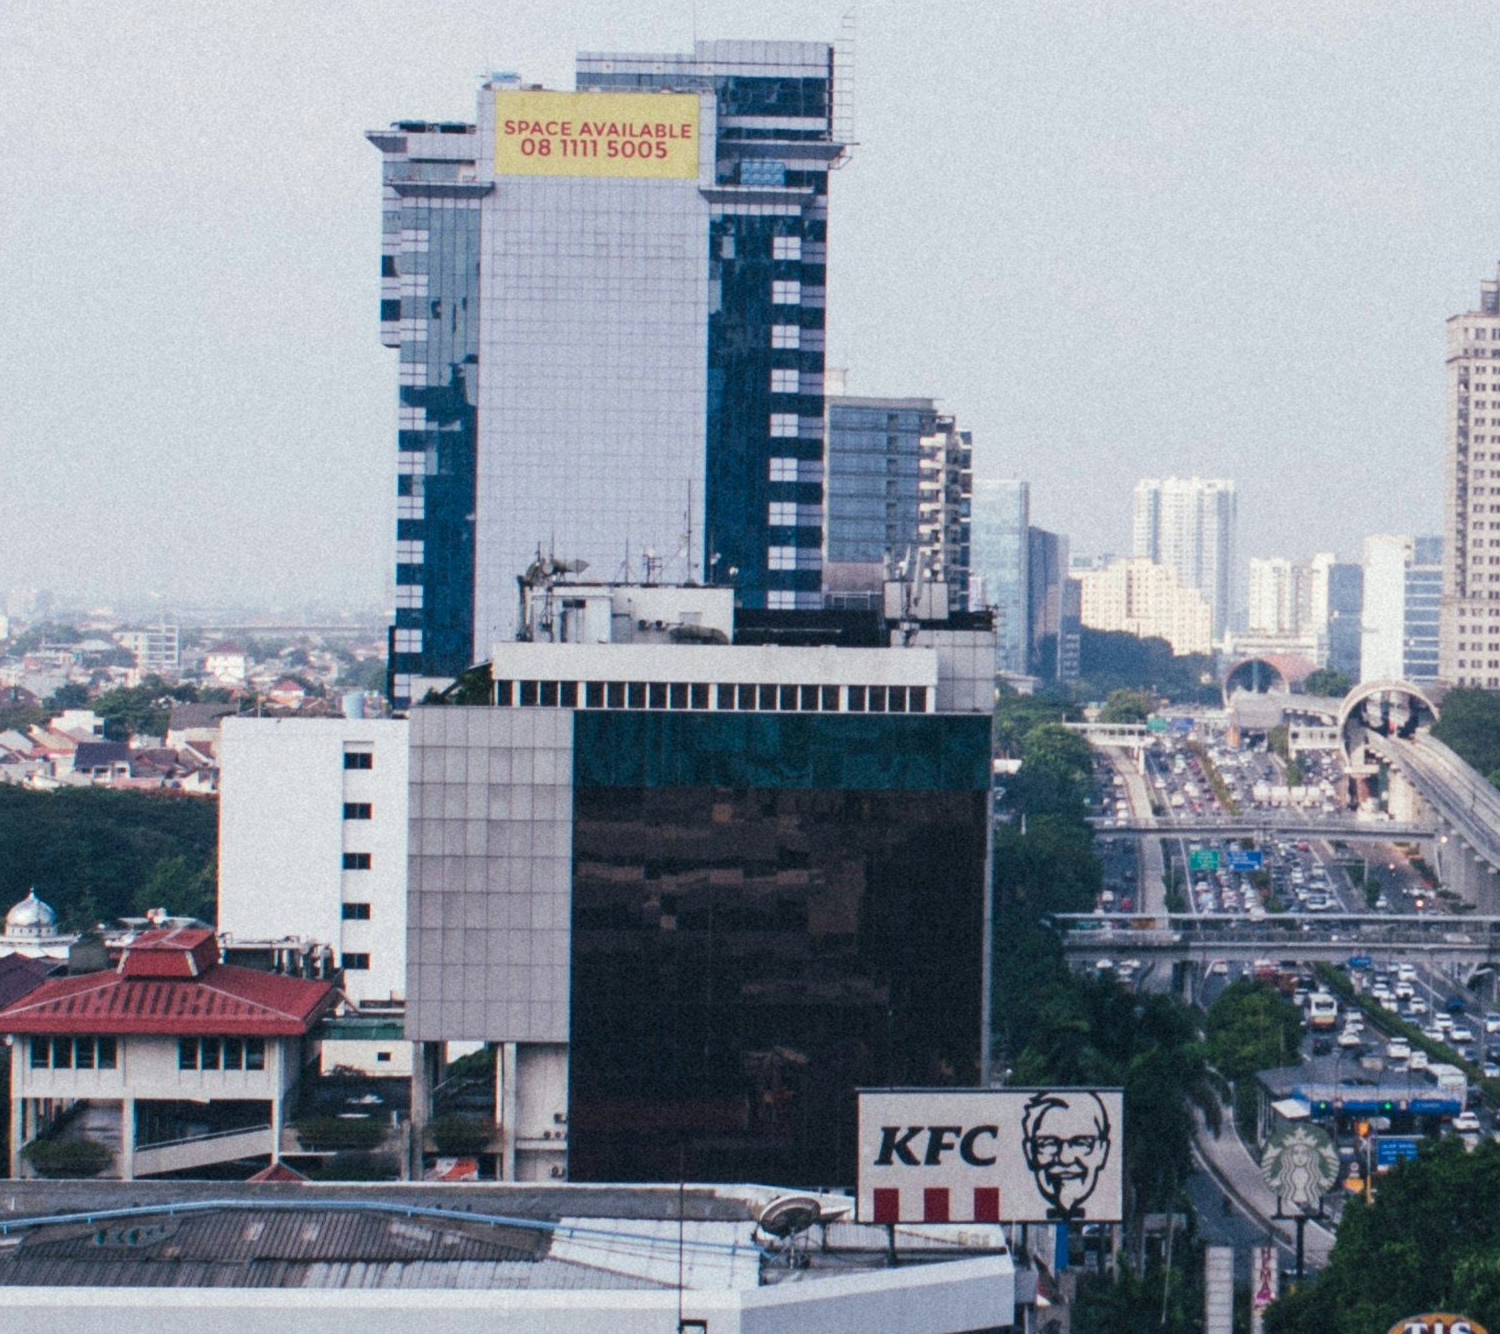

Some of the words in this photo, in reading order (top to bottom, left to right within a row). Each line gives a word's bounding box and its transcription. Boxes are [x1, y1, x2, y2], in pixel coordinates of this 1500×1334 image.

[504, 120, 572, 136] SPACE
[579, 121, 692, 139] AVAILABLE
[520, 138, 552, 156] 08
[560, 139, 598, 157] 1111
[607, 140, 668, 159] 5005
[873, 1125, 999, 1167] KFC
